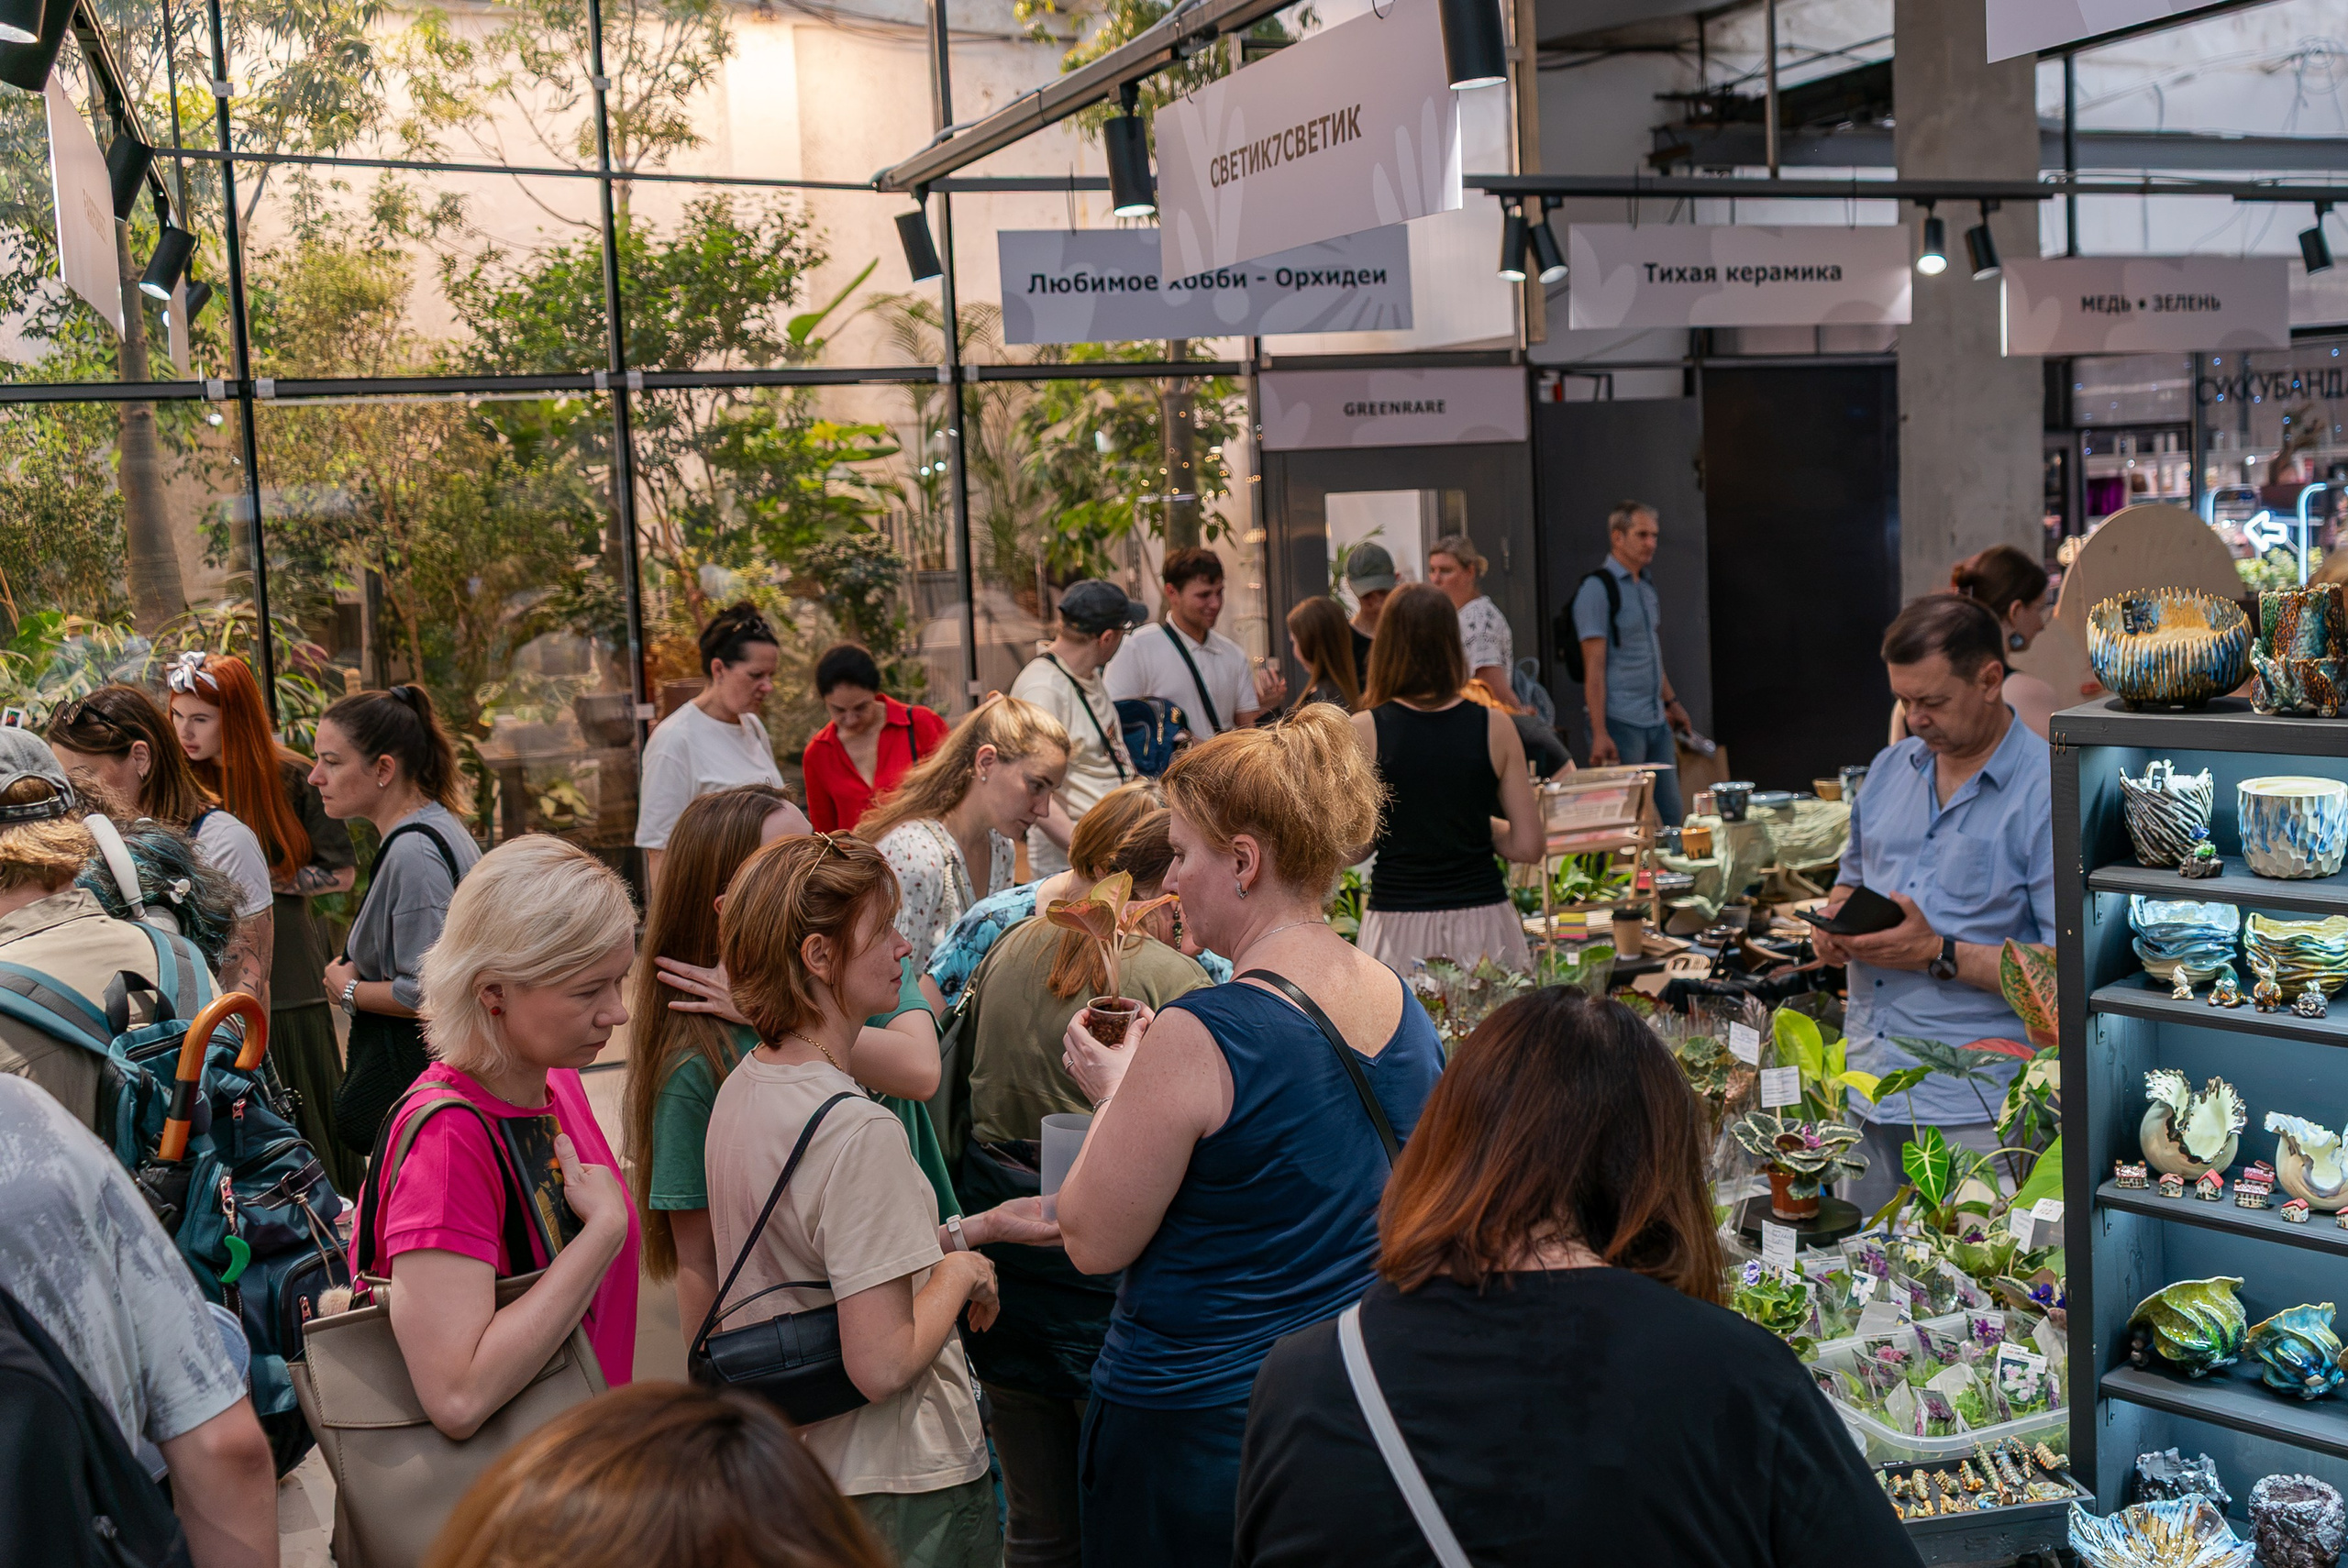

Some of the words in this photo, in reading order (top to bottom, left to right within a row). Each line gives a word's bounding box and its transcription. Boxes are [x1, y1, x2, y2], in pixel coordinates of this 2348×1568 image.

[1210, 104, 1362, 188] СВЕТИК7СВЕТИК
[1027, 271, 1158, 294] Любимое
[1276, 268, 1387, 291] Орхидеи
[1644, 262, 1717, 283] Тихая
[1726, 265, 1843, 287] керамика
[2081, 295, 2132, 315] МЕДЬ
[2153, 293, 2221, 313] ЗЕЛЕНЬ
[2197, 369, 2348, 405] СУККУБАНД
[1343, 400, 1446, 417] GREENRARE
